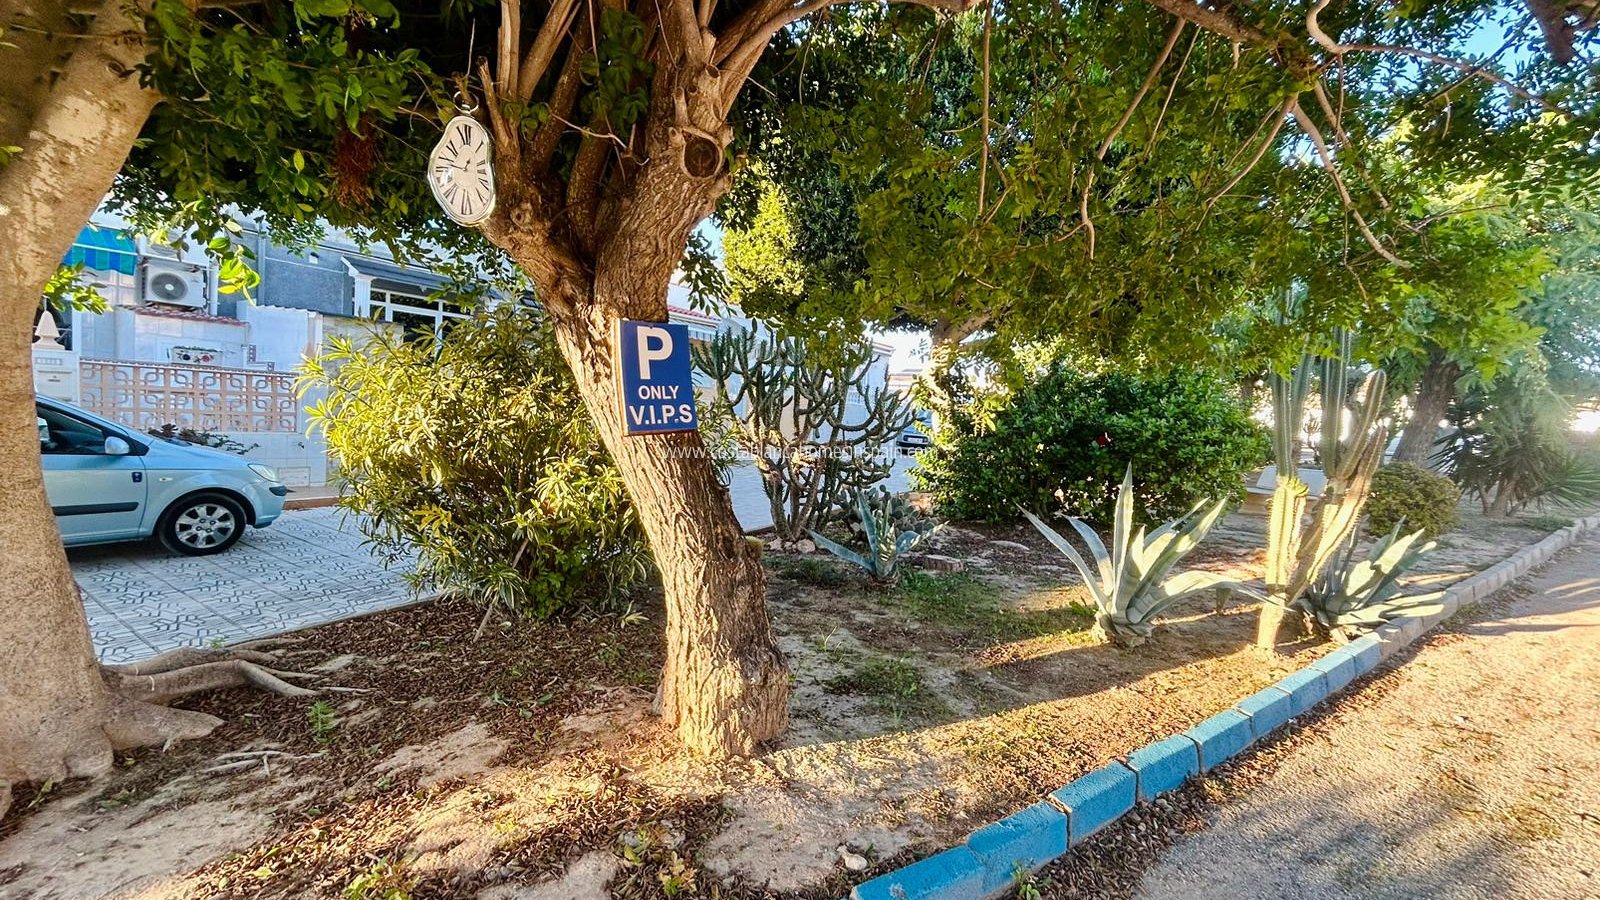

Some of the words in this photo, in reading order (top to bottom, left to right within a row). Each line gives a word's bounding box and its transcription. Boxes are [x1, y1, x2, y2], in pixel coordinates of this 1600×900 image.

[636, 325, 674, 380] P
[638, 385, 680, 400] ONLY
[628, 403, 693, 426] V.I.P.S
